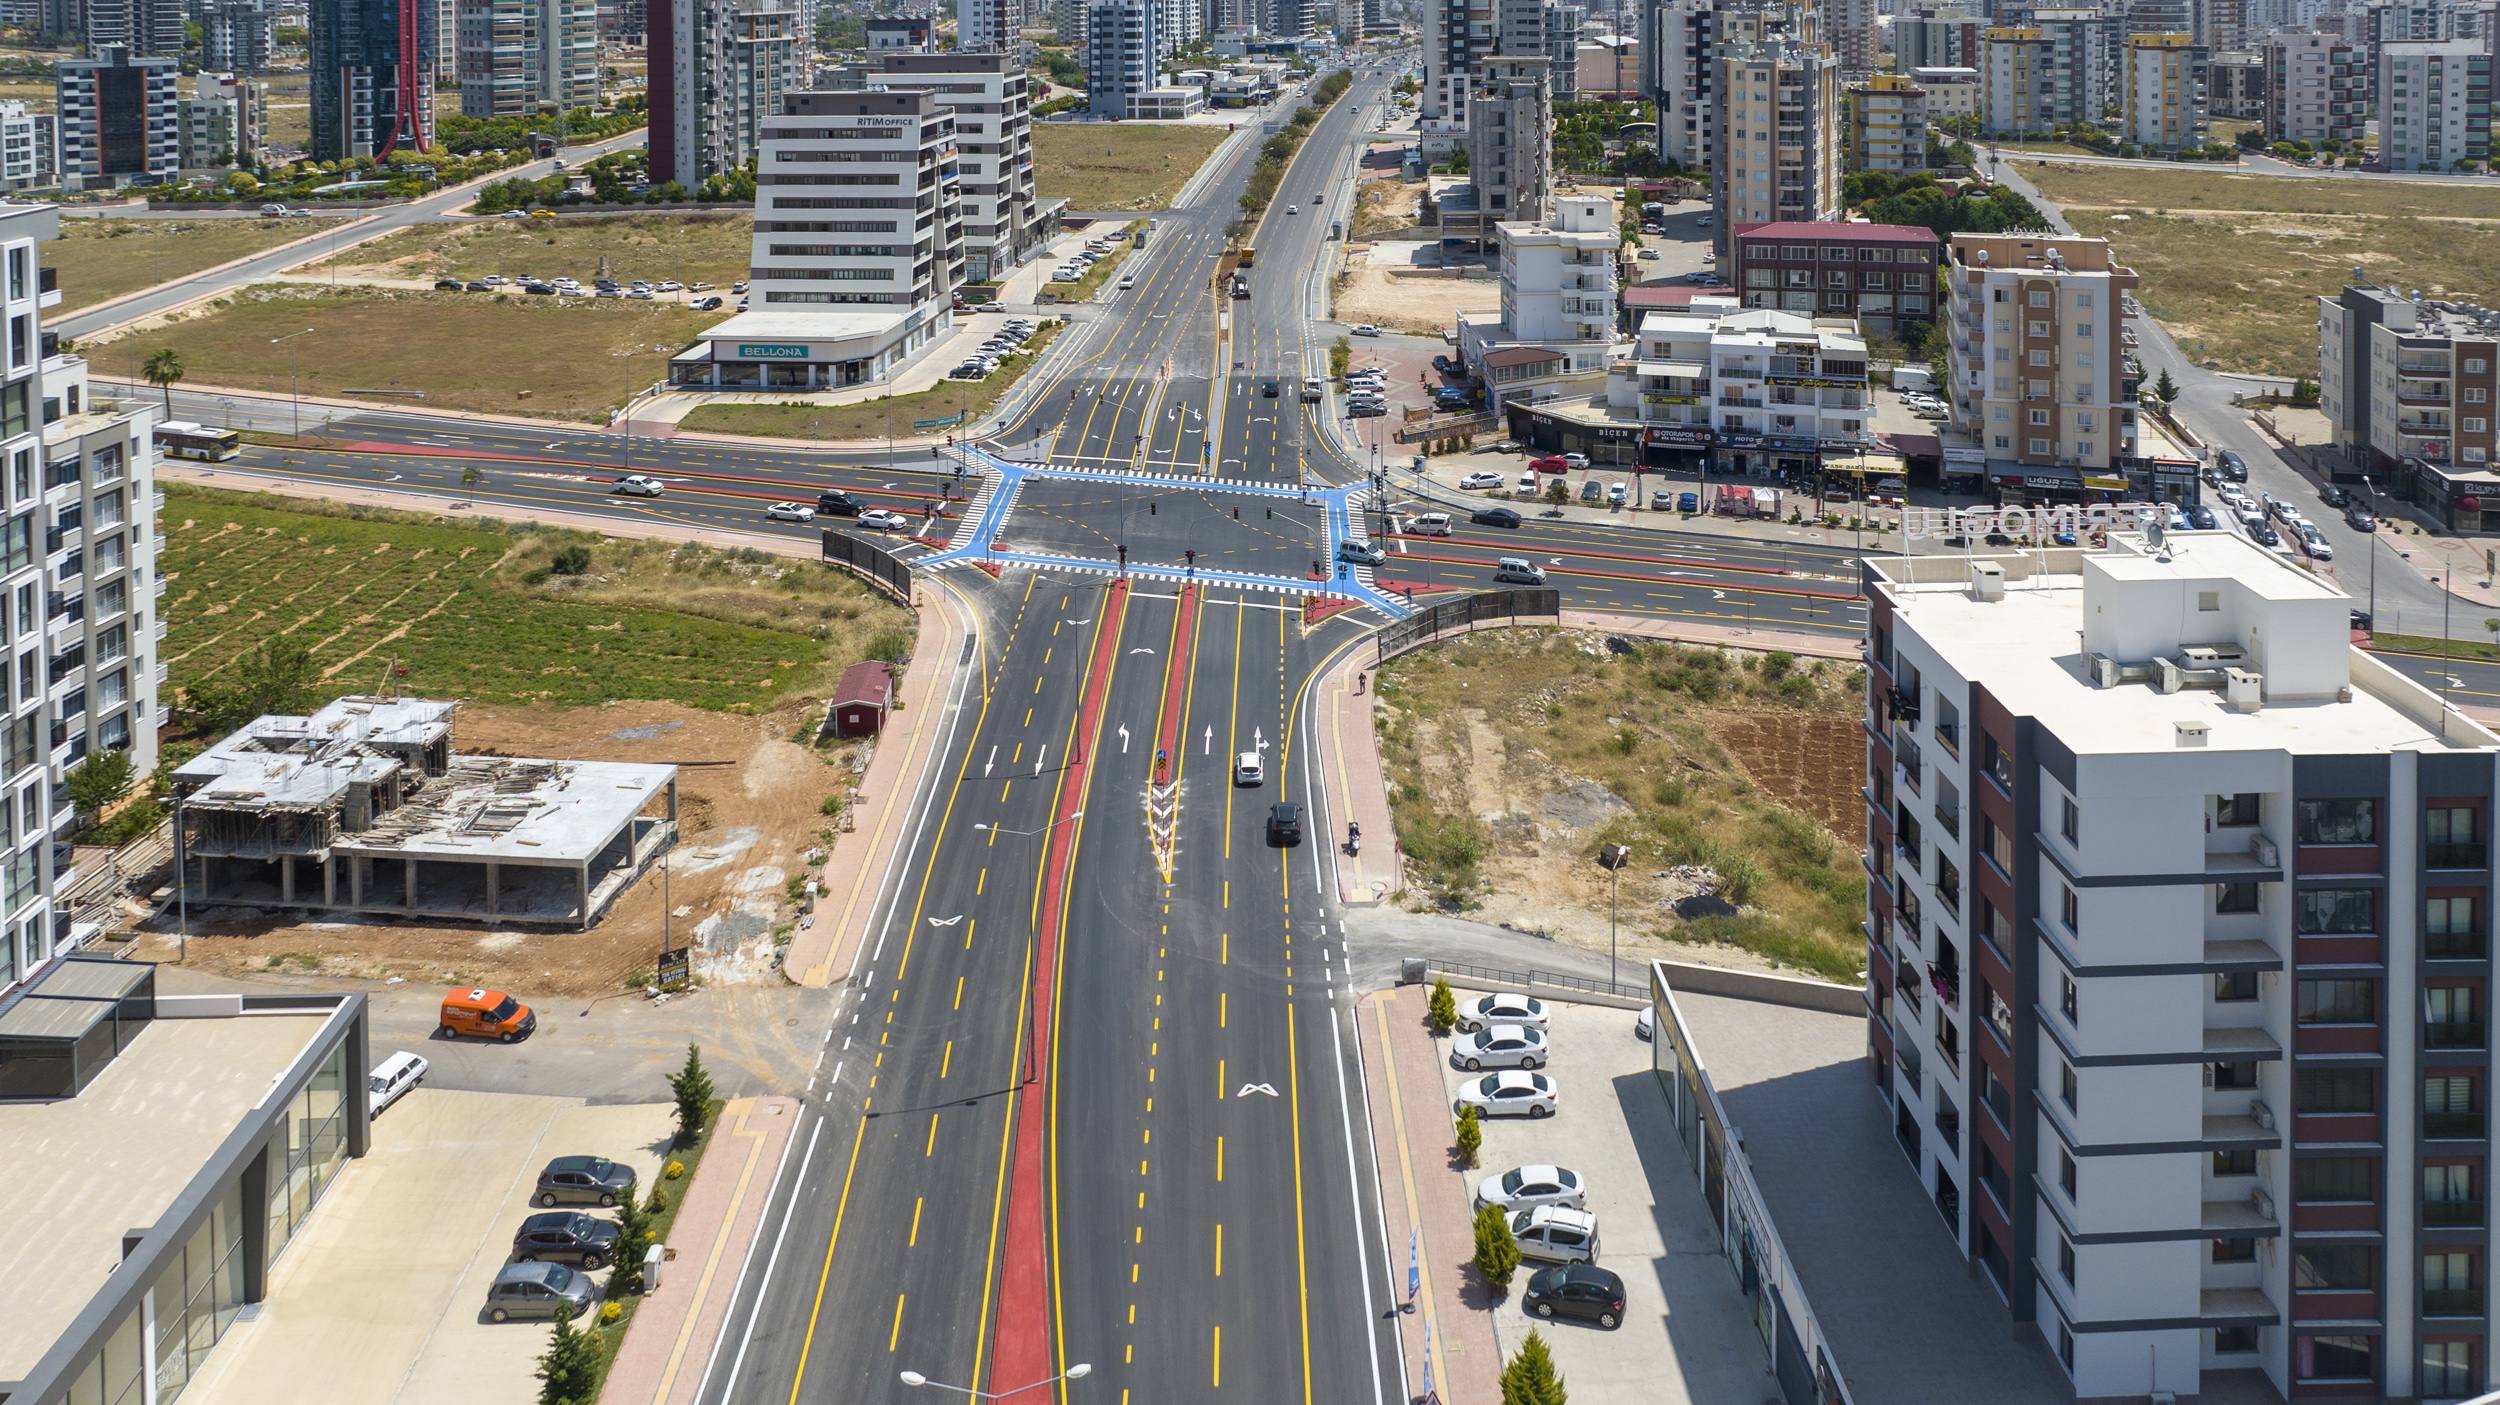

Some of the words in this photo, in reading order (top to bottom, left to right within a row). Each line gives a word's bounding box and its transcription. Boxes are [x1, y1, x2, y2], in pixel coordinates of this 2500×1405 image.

[885, 118, 913, 126] OFFICE
[744, 347, 803, 357] BELLONA
[1532, 413, 1553, 425] BİÇEN
[1598, 427, 1628, 438] BİÇEN
[1660, 430, 1695, 438] OTORAPOR
[1677, 1038, 1698, 1092] AUTO
